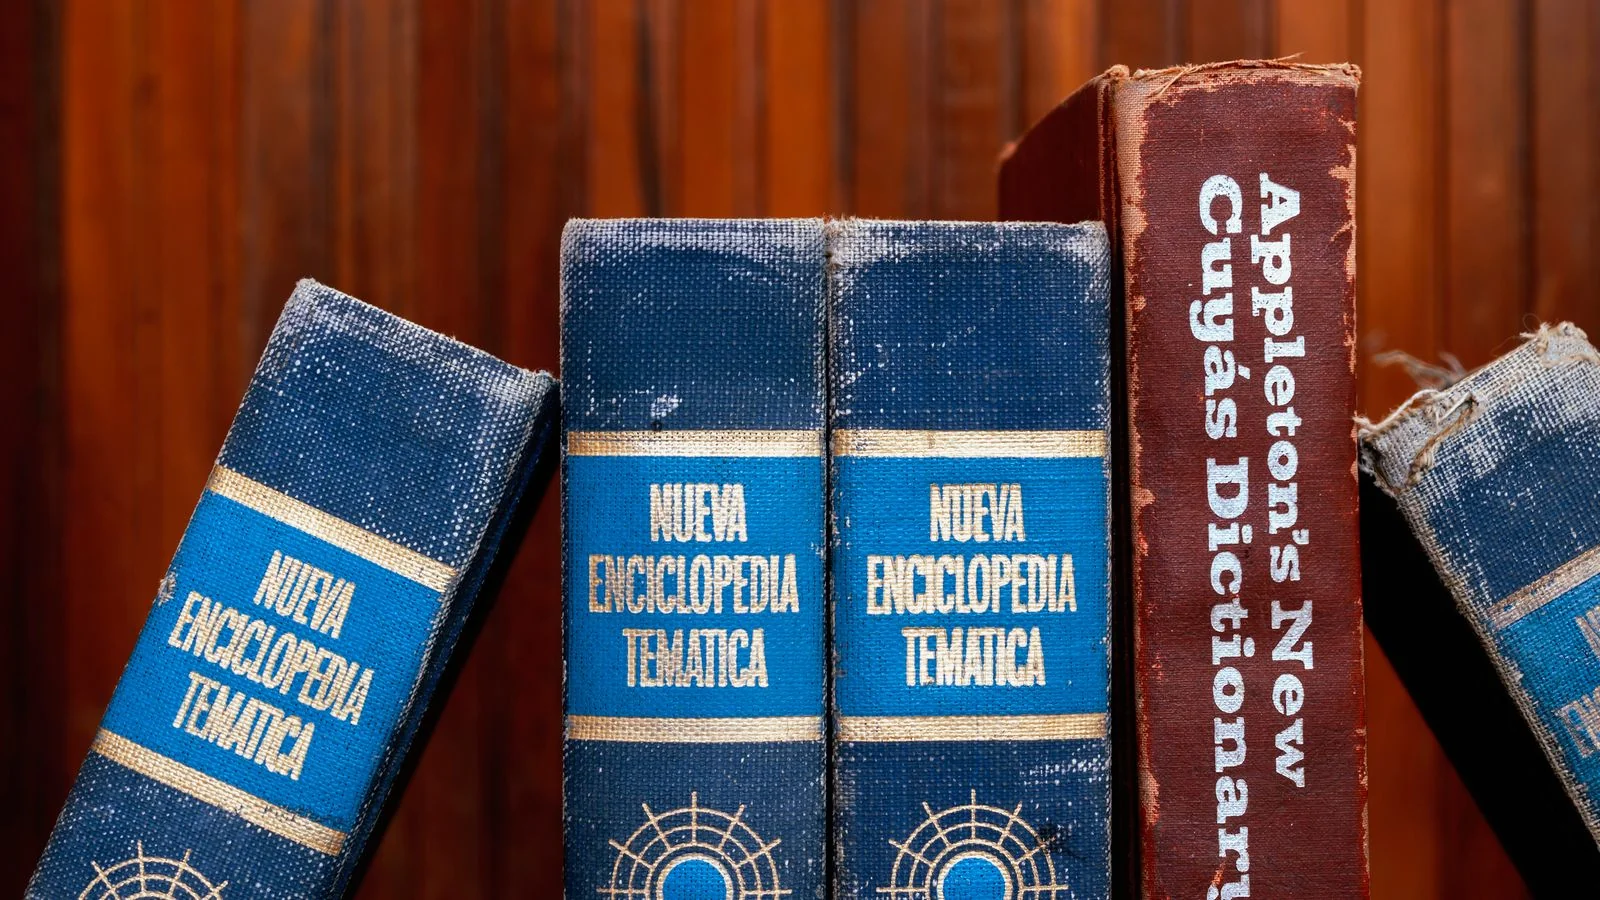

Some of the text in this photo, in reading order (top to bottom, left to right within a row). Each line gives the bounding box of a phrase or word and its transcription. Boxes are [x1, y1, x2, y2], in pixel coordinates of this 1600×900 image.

[1189, 174, 1251, 439] Cuyás
[1250, 172, 1314, 787] Appleton's New
[650, 483, 748, 542] NUEVA
[930, 483, 1025, 542] NUEVA
[253, 550, 356, 639] NUEVA
[588, 554, 800, 614] ENCICLOPEDIA
[866, 554, 1078, 615] ENCICLOPEDIA
[168, 591, 374, 726] ENCICLOPEDIA
[622, 628, 768, 687] TEMATICA
[902, 626, 1046, 687] TEMATICA
[172, 671, 315, 781] TEMATICA
